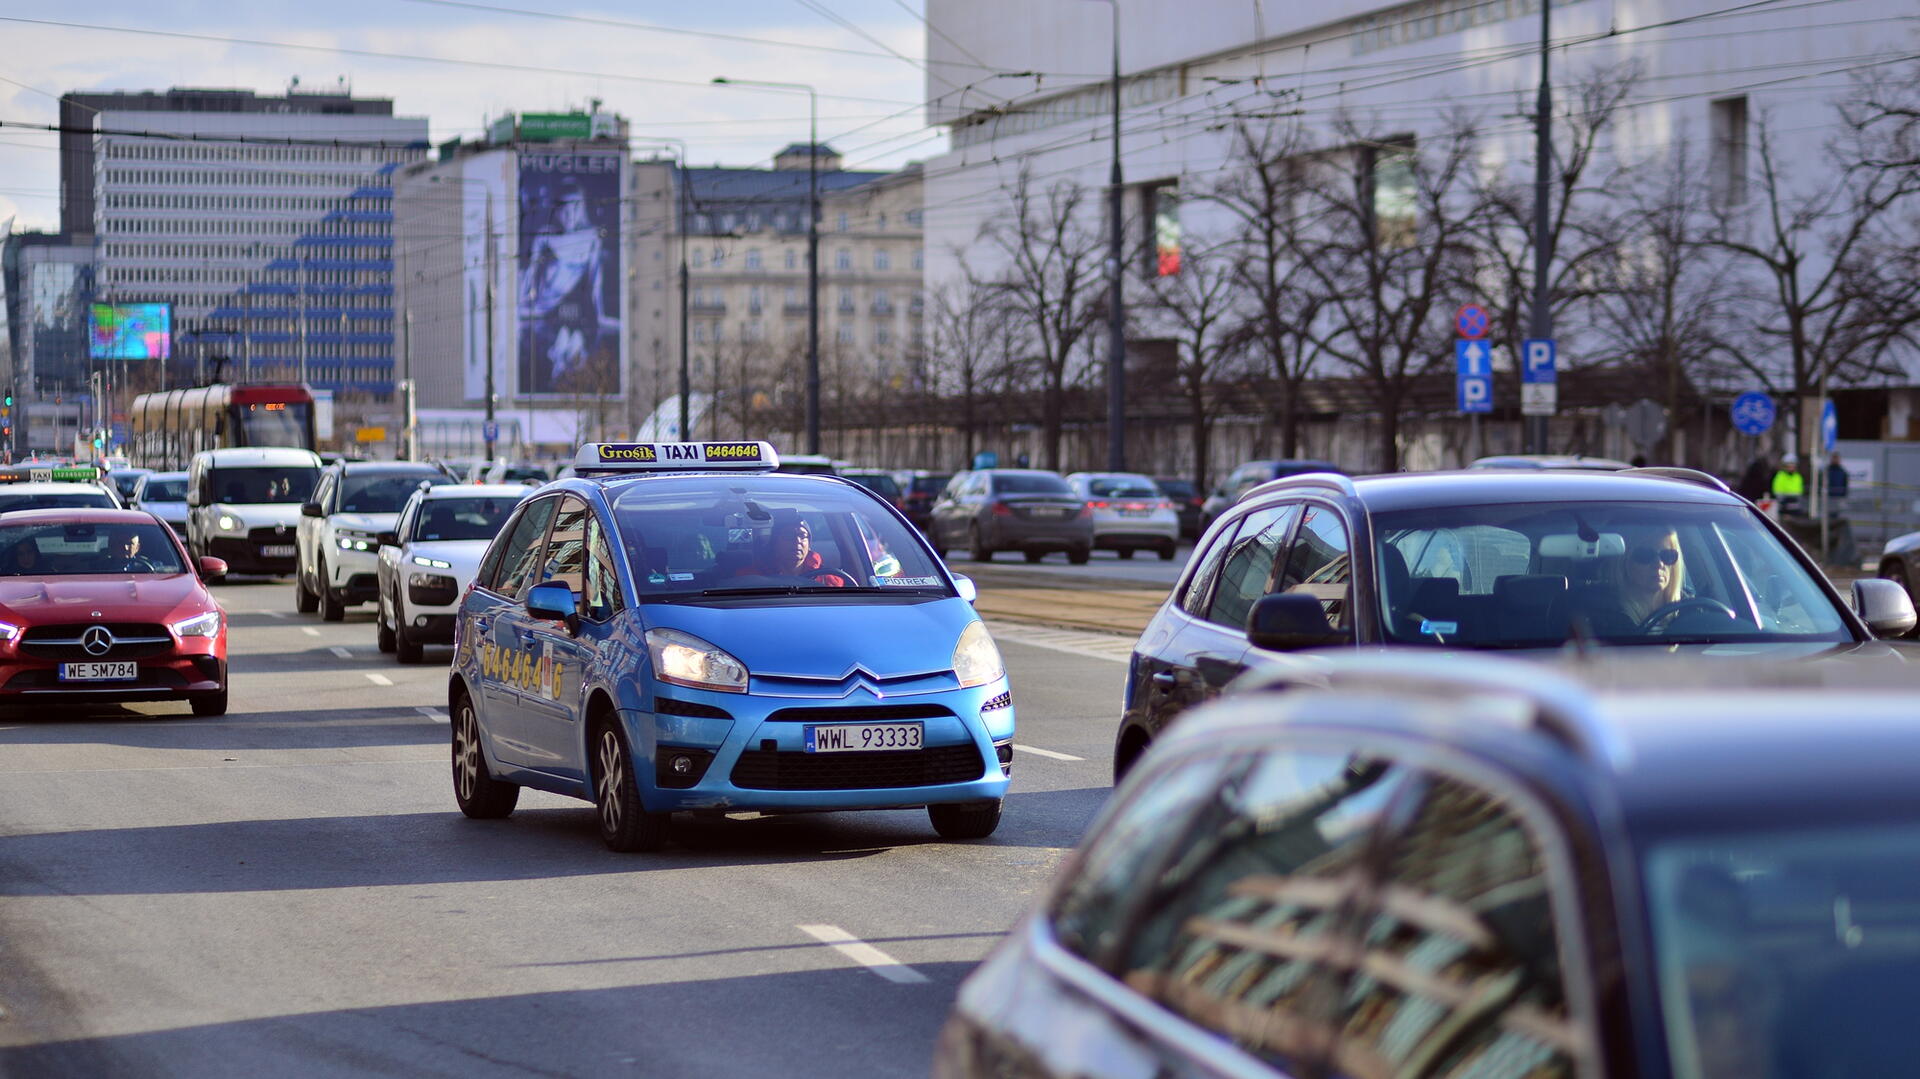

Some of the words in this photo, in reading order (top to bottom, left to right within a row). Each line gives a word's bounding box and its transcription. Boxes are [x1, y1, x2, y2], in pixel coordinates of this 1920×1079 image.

[520, 156, 616, 174] MUGLER
[1528, 342, 1551, 372] P
[662, 445, 698, 460] TAXI
[706, 445, 758, 458] 6464646
[32, 471, 51, 480] TAXI
[68, 664, 86, 678] WE
[91, 663, 134, 677] 5M784
[817, 728, 854, 750] WWL
[861, 727, 920, 749] 93333
